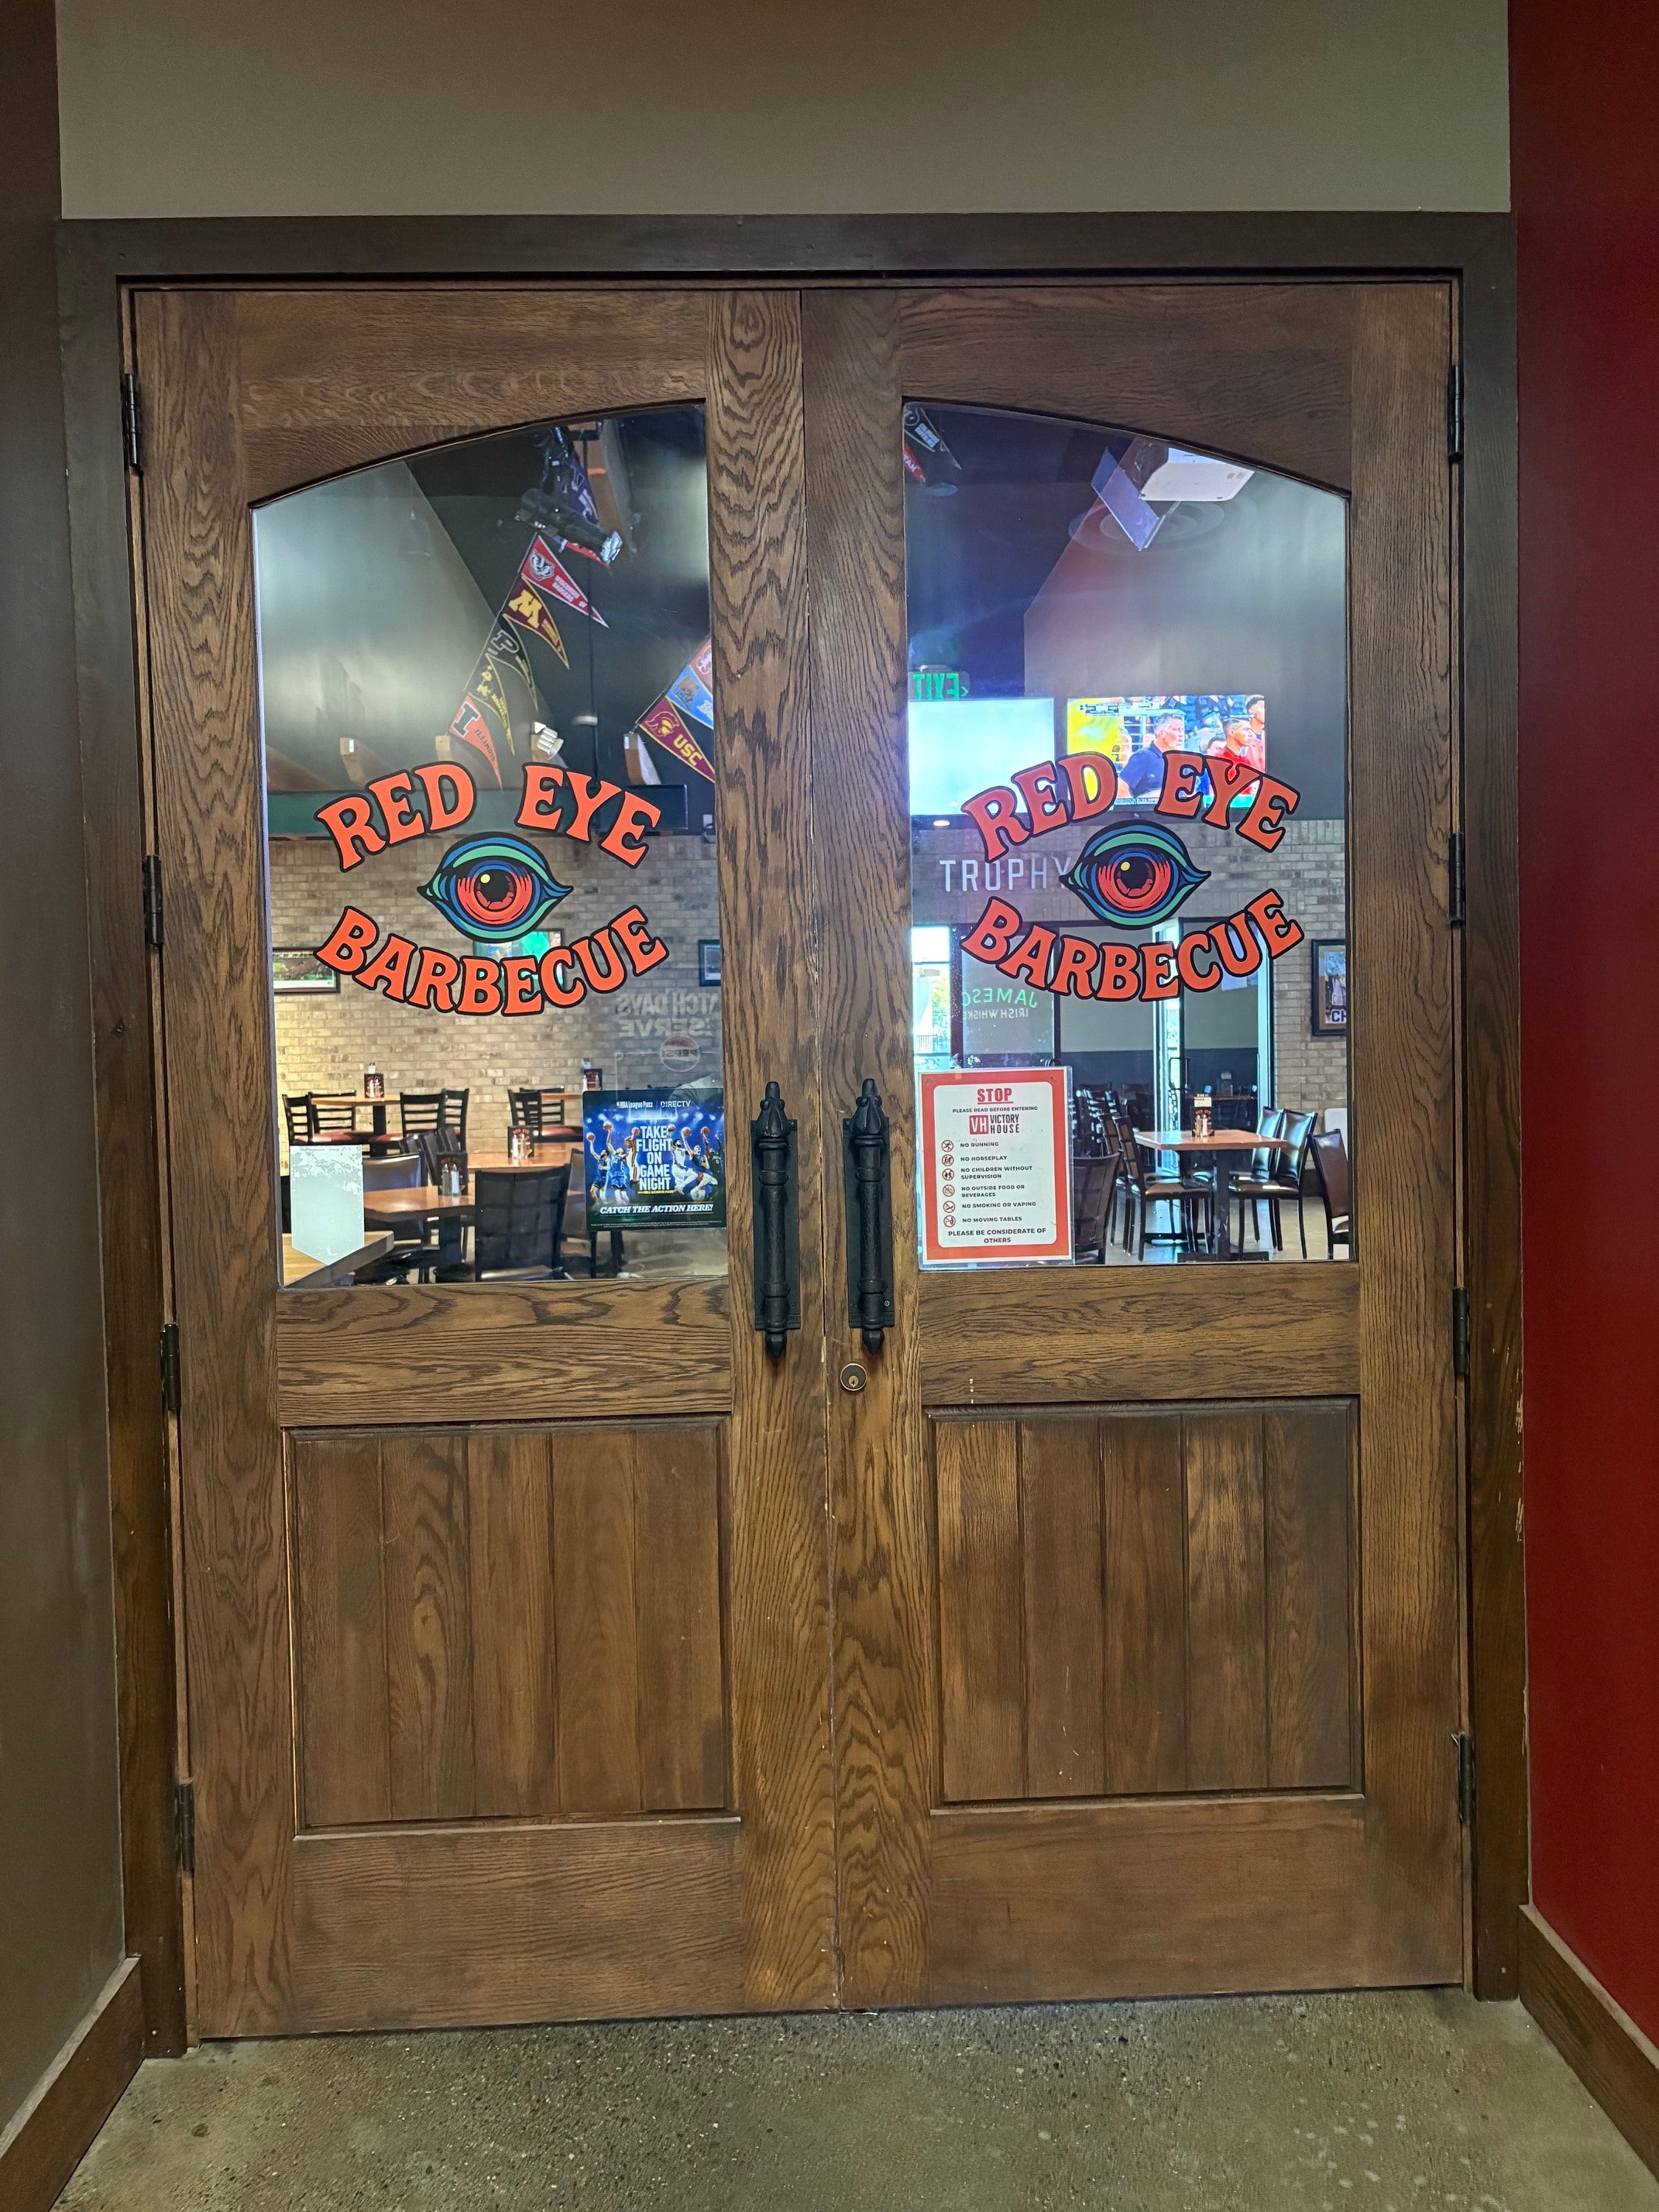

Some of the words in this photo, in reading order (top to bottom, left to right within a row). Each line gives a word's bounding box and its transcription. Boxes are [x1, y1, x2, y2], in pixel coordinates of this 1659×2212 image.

[474, 729, 496, 762] ILLINOIS
[673, 734, 703, 766] USC
[960, 751, 1118, 863] RED
[1154, 750, 1301, 853] EYE
[314, 761, 476, 872] RED
[514, 761, 662, 868] EYE
[939, 855, 1072, 891] TROPHY
[959, 888, 1305, 1001] BARBECUE
[314, 905, 669, 1016] BARBECUE
[977, 1087, 1012, 1102] STOP
[628, 1101, 643, 1110] League
[970, 1117, 988, 1133] VH
[990, 1114, 1019, 1124] VICTORY
[640, 1125, 667, 1139] TAKE
[990, 1124, 1020, 1134] HOUSE
[636, 1139, 672, 1152] FLIGHT
[647, 1151, 662, 1165] ON
[640, 1164, 670, 1177] GAME
[639, 1177, 672, 1190] NIGHT
[600, 1205, 630, 1214] CATCH
[651, 1204, 686, 1213] ACTION
